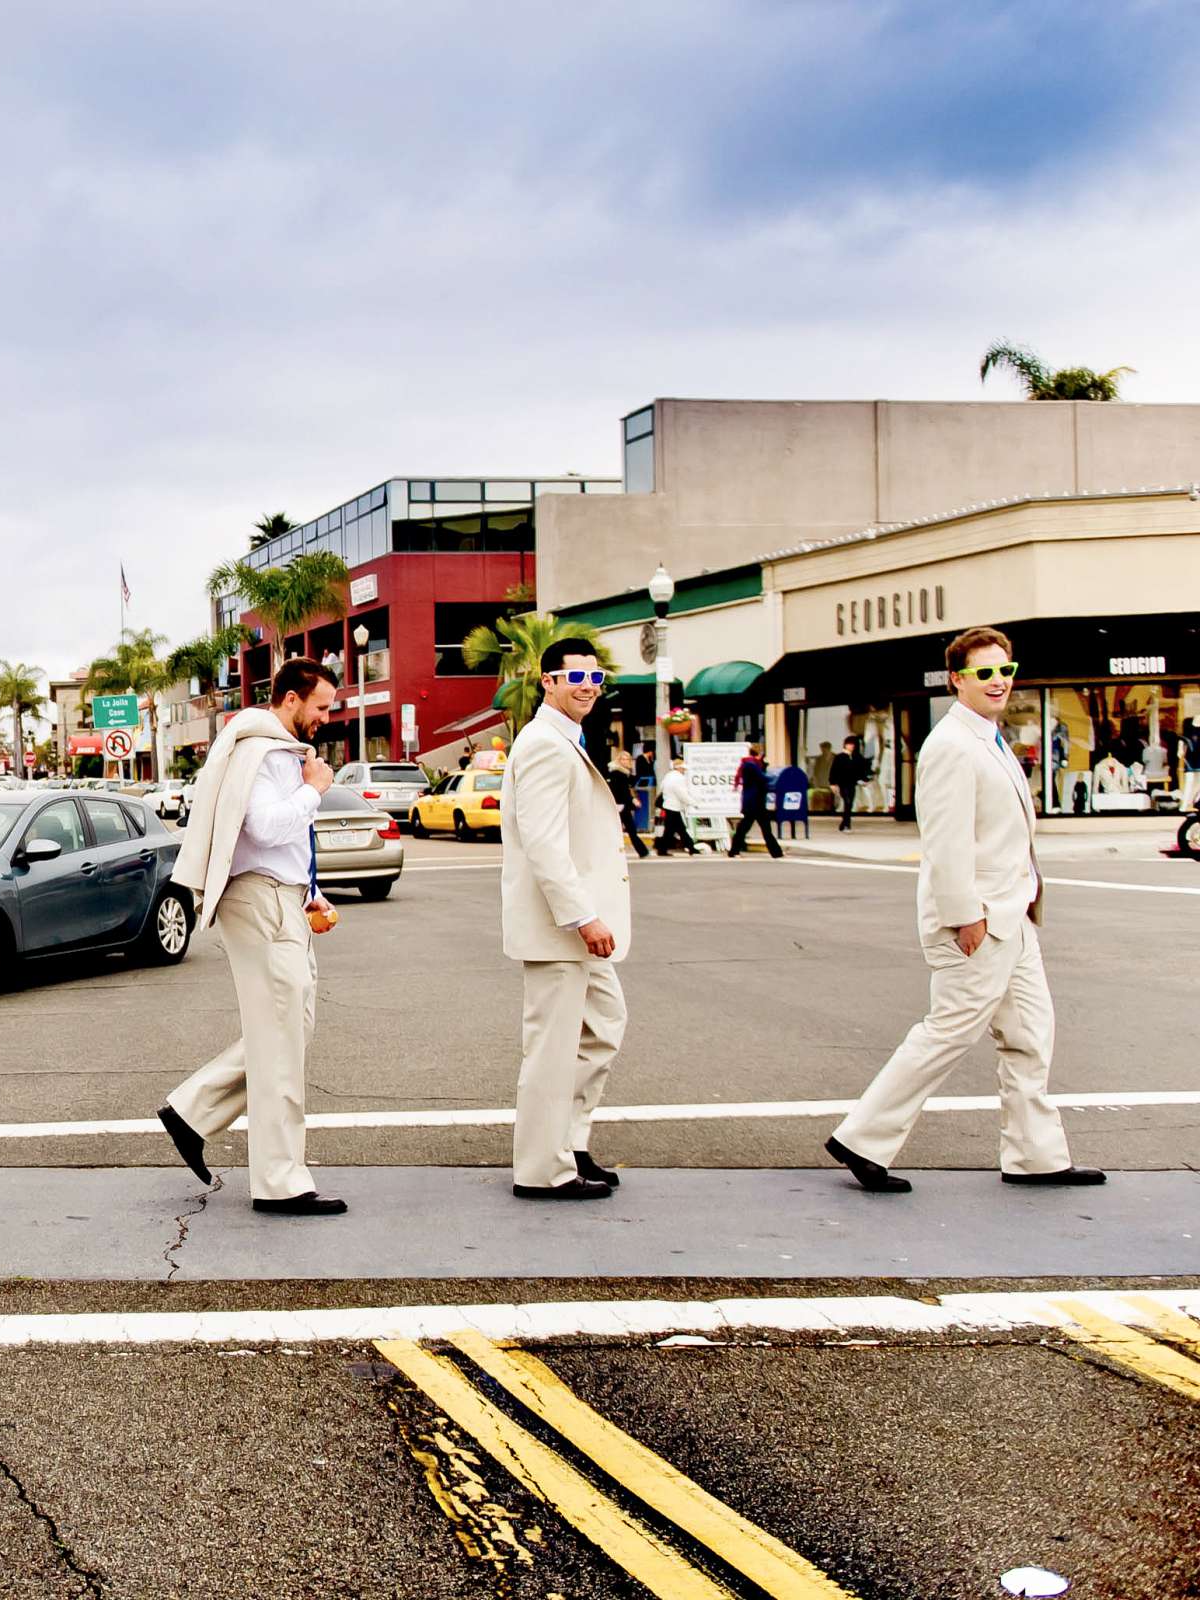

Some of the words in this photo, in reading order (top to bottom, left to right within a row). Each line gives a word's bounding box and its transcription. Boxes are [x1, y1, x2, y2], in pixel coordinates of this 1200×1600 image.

[836, 585, 944, 636] GEORGIOU
[112, 698, 129, 706] Jolla
[691, 775, 735, 786] CLOSE
